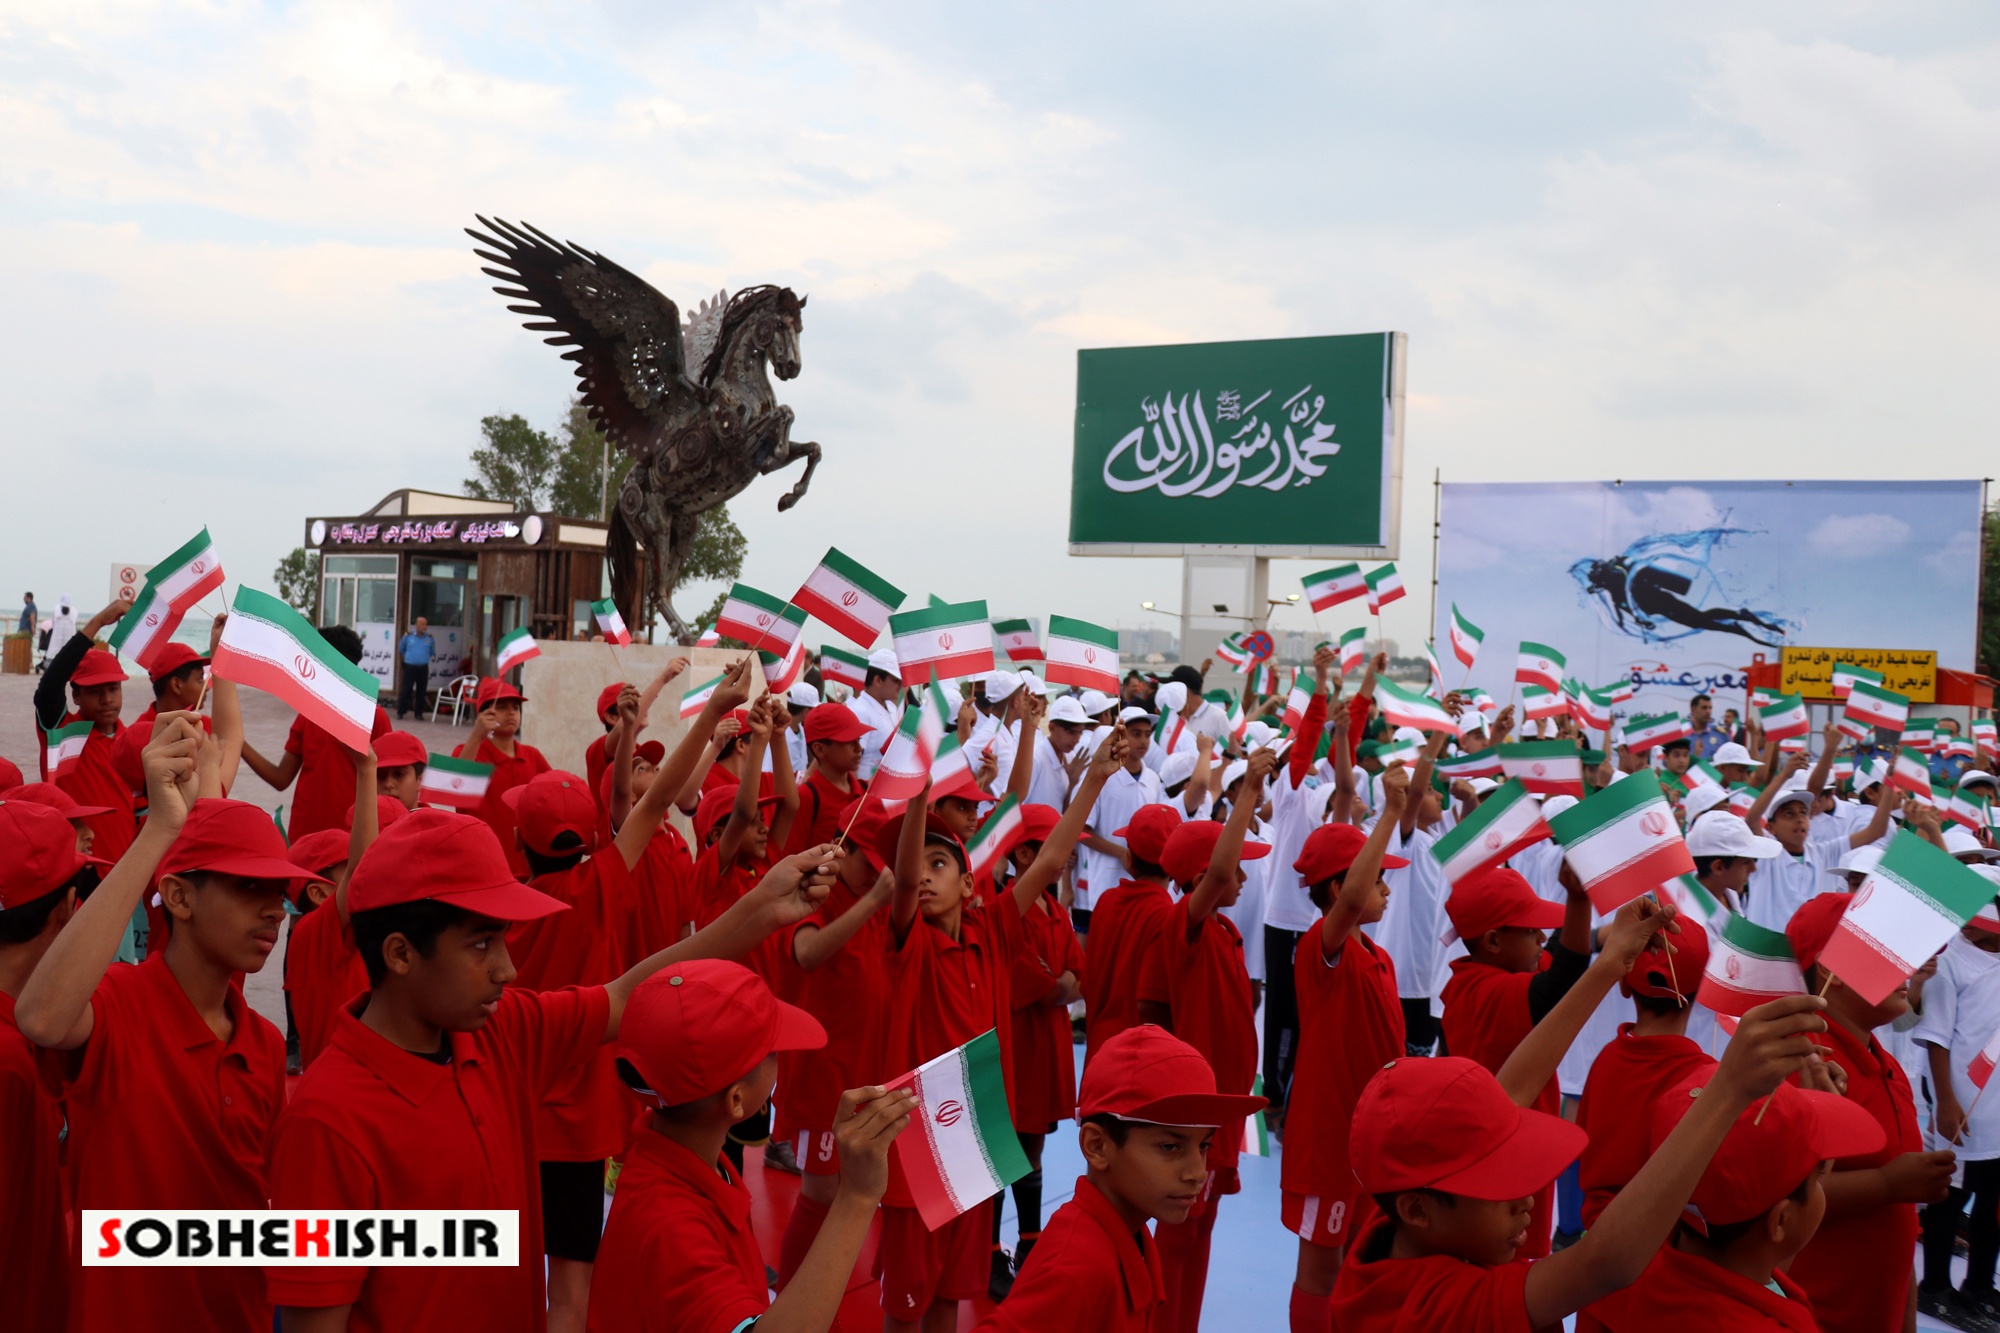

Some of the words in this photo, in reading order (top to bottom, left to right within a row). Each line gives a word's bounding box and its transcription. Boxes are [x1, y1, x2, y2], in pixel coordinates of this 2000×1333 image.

[357, 523, 379, 544] کنترل
[381, 521, 411, 543] تفریحی
[432, 521, 457, 538] اسکله
[1787, 650, 1812, 664] تندرو
[1886, 653, 1908, 668] بلیط
[1897, 674, 1931, 690] تفریحی
[818, 1131, 835, 1161] 9
[1327, 1200, 1346, 1234] 8
